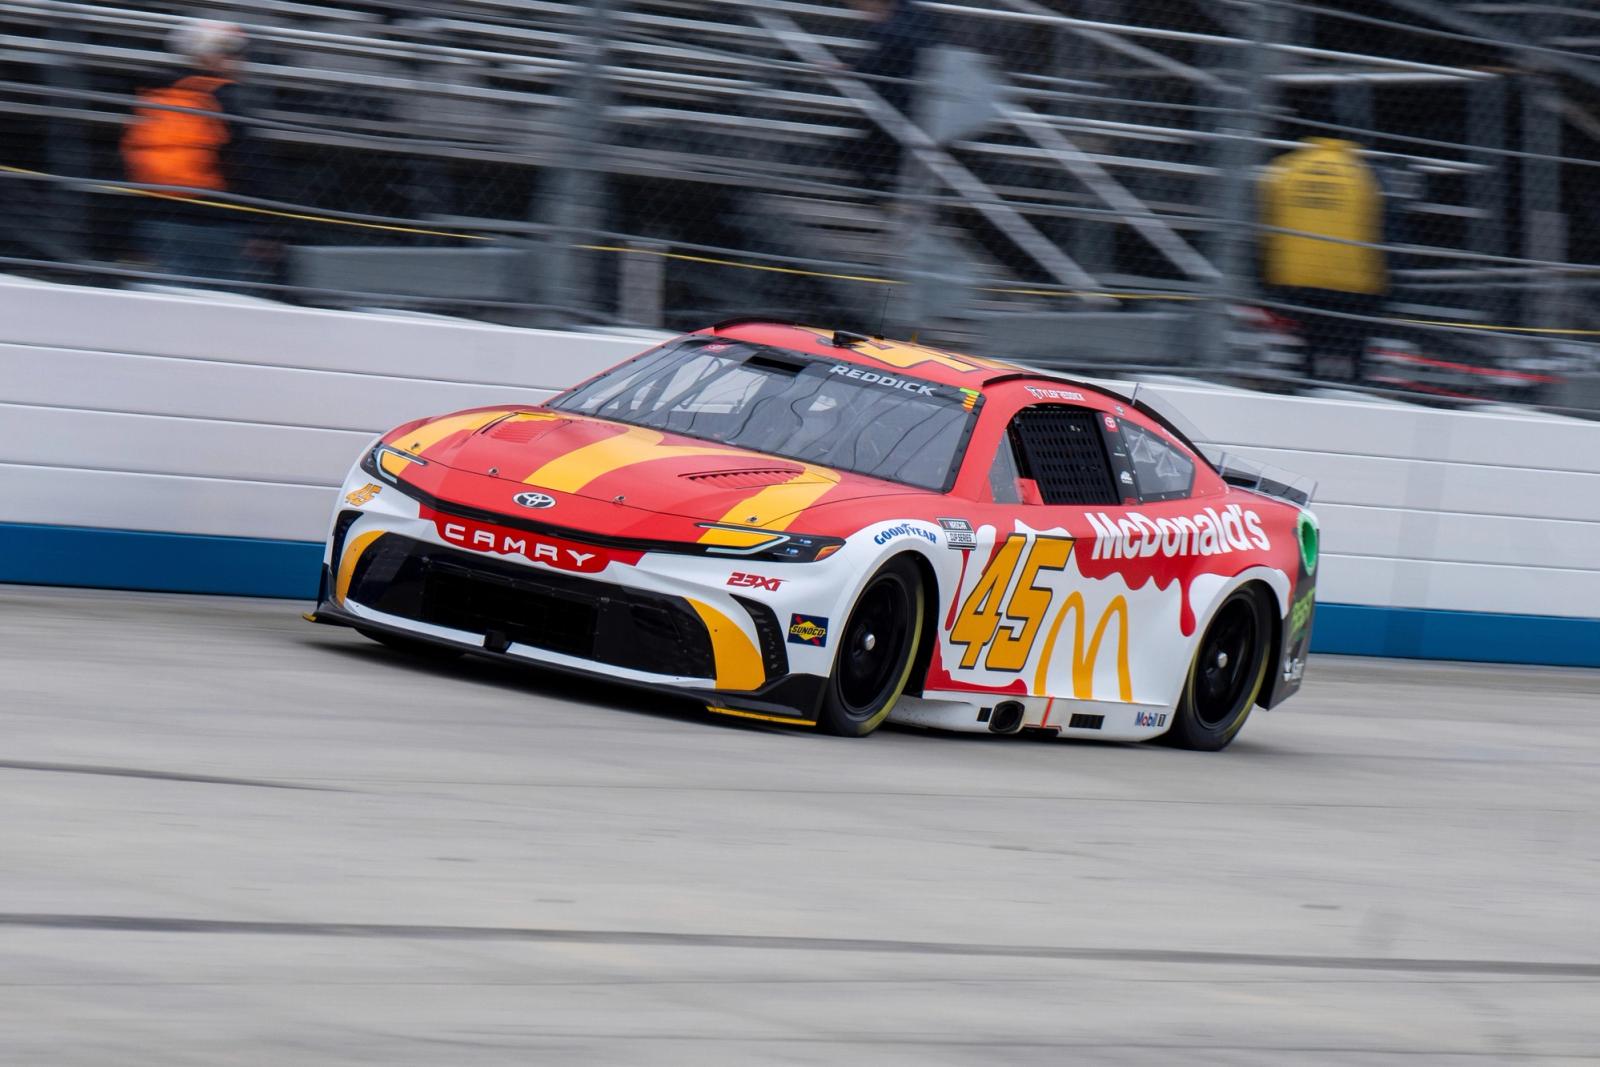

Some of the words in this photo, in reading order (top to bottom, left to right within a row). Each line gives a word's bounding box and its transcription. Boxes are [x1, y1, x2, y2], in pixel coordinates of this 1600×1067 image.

[829, 365, 938, 397] REDDICK
[345, 482, 382, 507] 45
[445, 523, 595, 567] CAMRY
[873, 522, 937, 545] GOODYEAR
[1084, 504, 1271, 560] McDonald's
[949, 531, 1078, 673] 45
[791, 624, 825, 637] SUNOCO
[1135, 711, 1159, 728] Mobil
